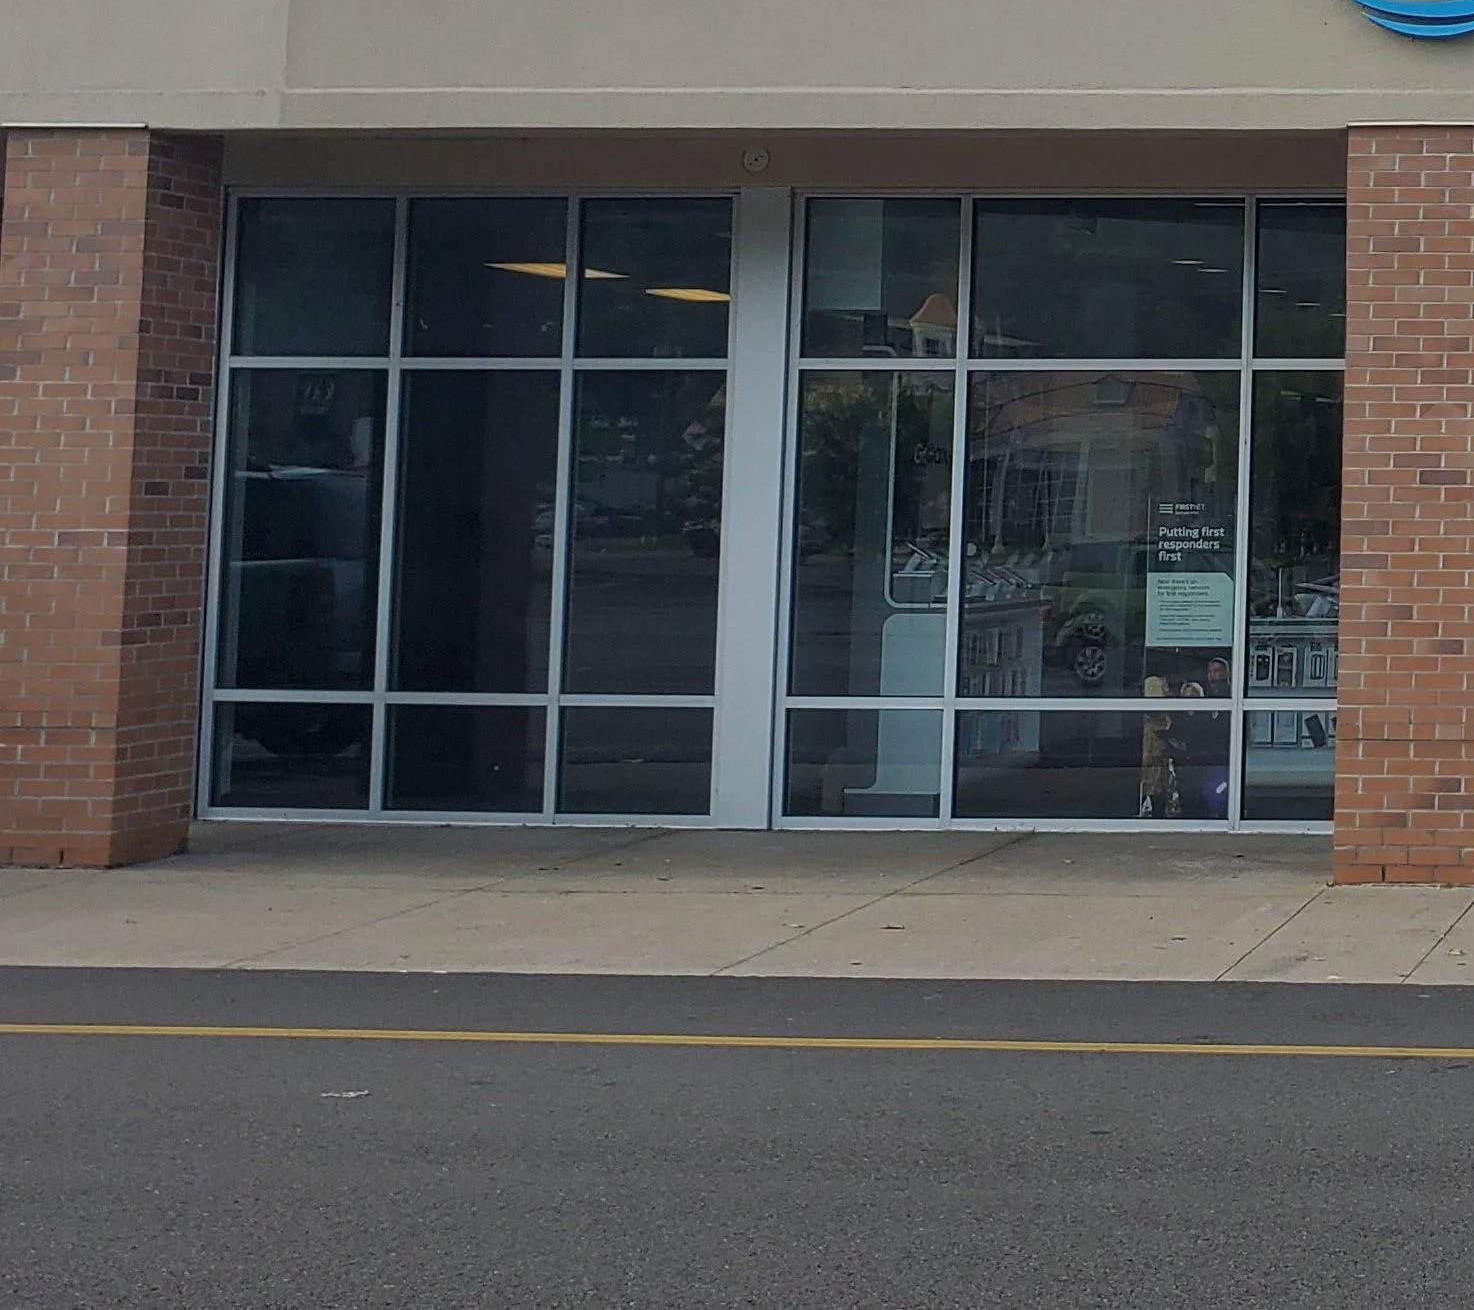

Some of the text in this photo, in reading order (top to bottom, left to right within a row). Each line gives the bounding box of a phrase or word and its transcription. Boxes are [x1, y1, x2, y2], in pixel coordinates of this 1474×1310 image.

[1159, 527, 1225, 539] Putting first
[1158, 539, 1220, 551] responders
[1158, 551, 1182, 562] first
